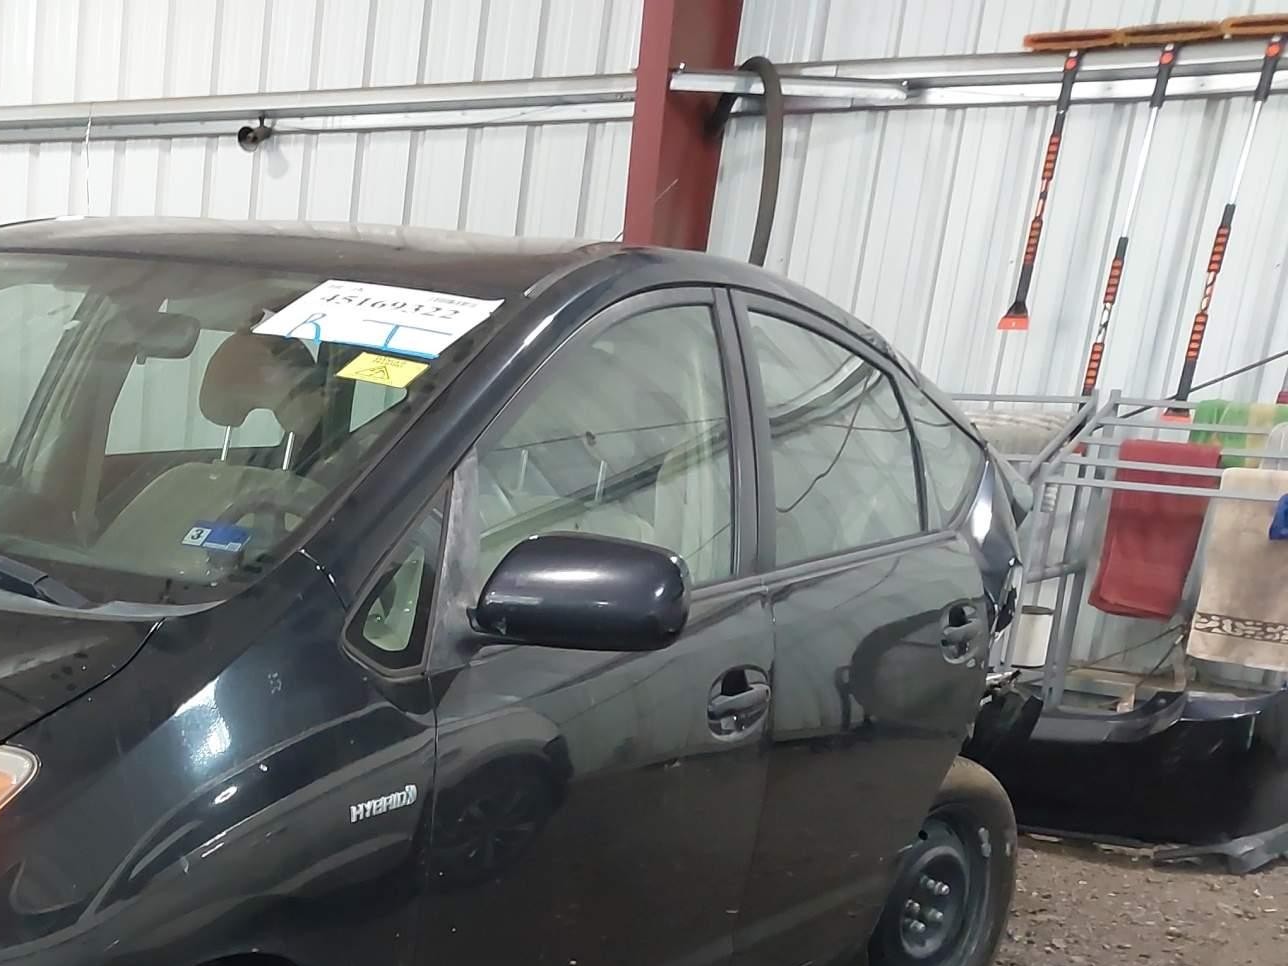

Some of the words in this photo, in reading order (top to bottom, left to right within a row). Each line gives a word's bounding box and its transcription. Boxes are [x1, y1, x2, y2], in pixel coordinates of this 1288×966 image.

[320, 293, 461, 321] 45169322
[190, 528, 204, 541] 3
[349, 791, 407, 823] HYBRID
